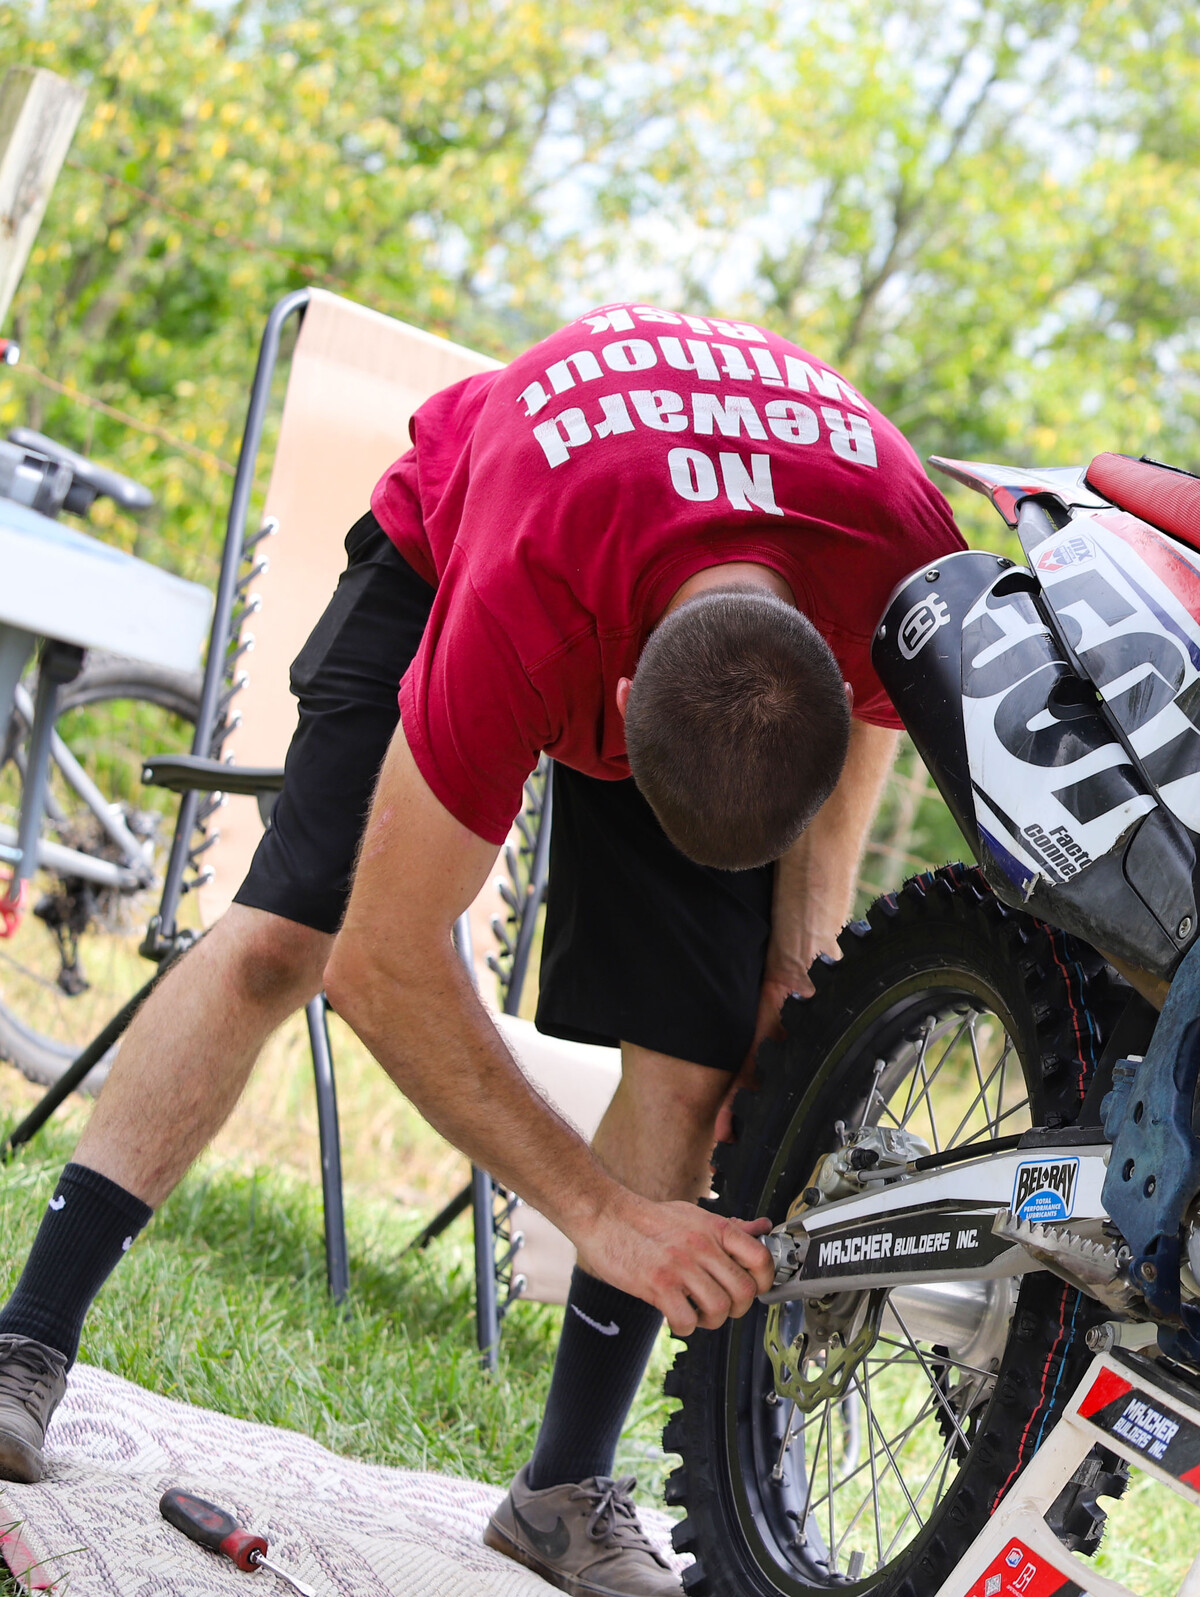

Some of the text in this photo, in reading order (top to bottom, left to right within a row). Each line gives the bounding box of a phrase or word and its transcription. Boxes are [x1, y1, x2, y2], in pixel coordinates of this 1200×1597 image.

[581, 306, 768, 344] Risk
[516, 336, 870, 418] Without
[532, 389, 878, 469] Reward
[667, 447, 785, 516] No
[818, 1229, 979, 1267] MAJCHER BUILDERS INC.
[1112, 1416, 1153, 1449] BUILDERS
[1122, 1398, 1180, 1444] MAJCHER
